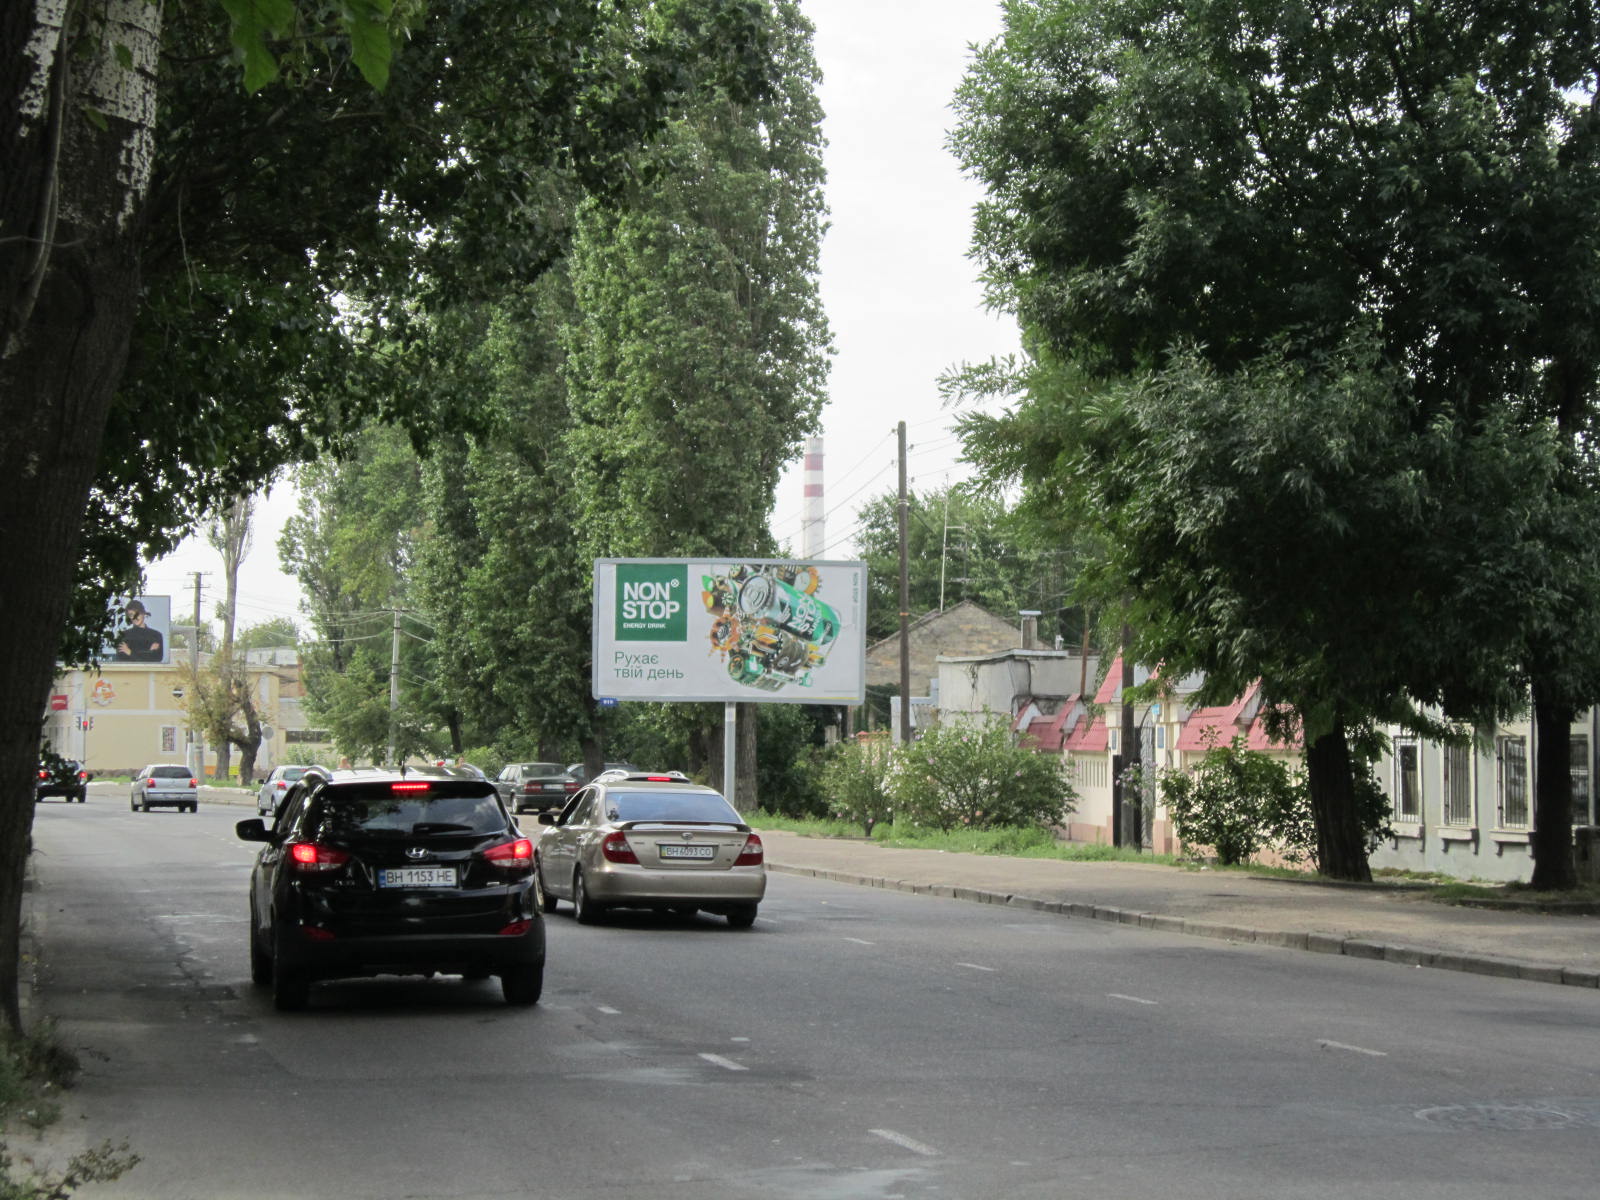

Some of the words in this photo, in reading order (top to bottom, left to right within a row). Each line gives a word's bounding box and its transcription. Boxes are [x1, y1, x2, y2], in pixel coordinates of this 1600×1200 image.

[624, 582, 670, 600] NON
[623, 601, 680, 619] STOP
[615, 651, 659, 667] Рухає
[614, 666, 642, 679] твій
[647, 668, 684, 680] день
[387, 872, 403, 883] BH
[407, 871, 434, 882] 1153
[437, 871, 452, 882] HE
